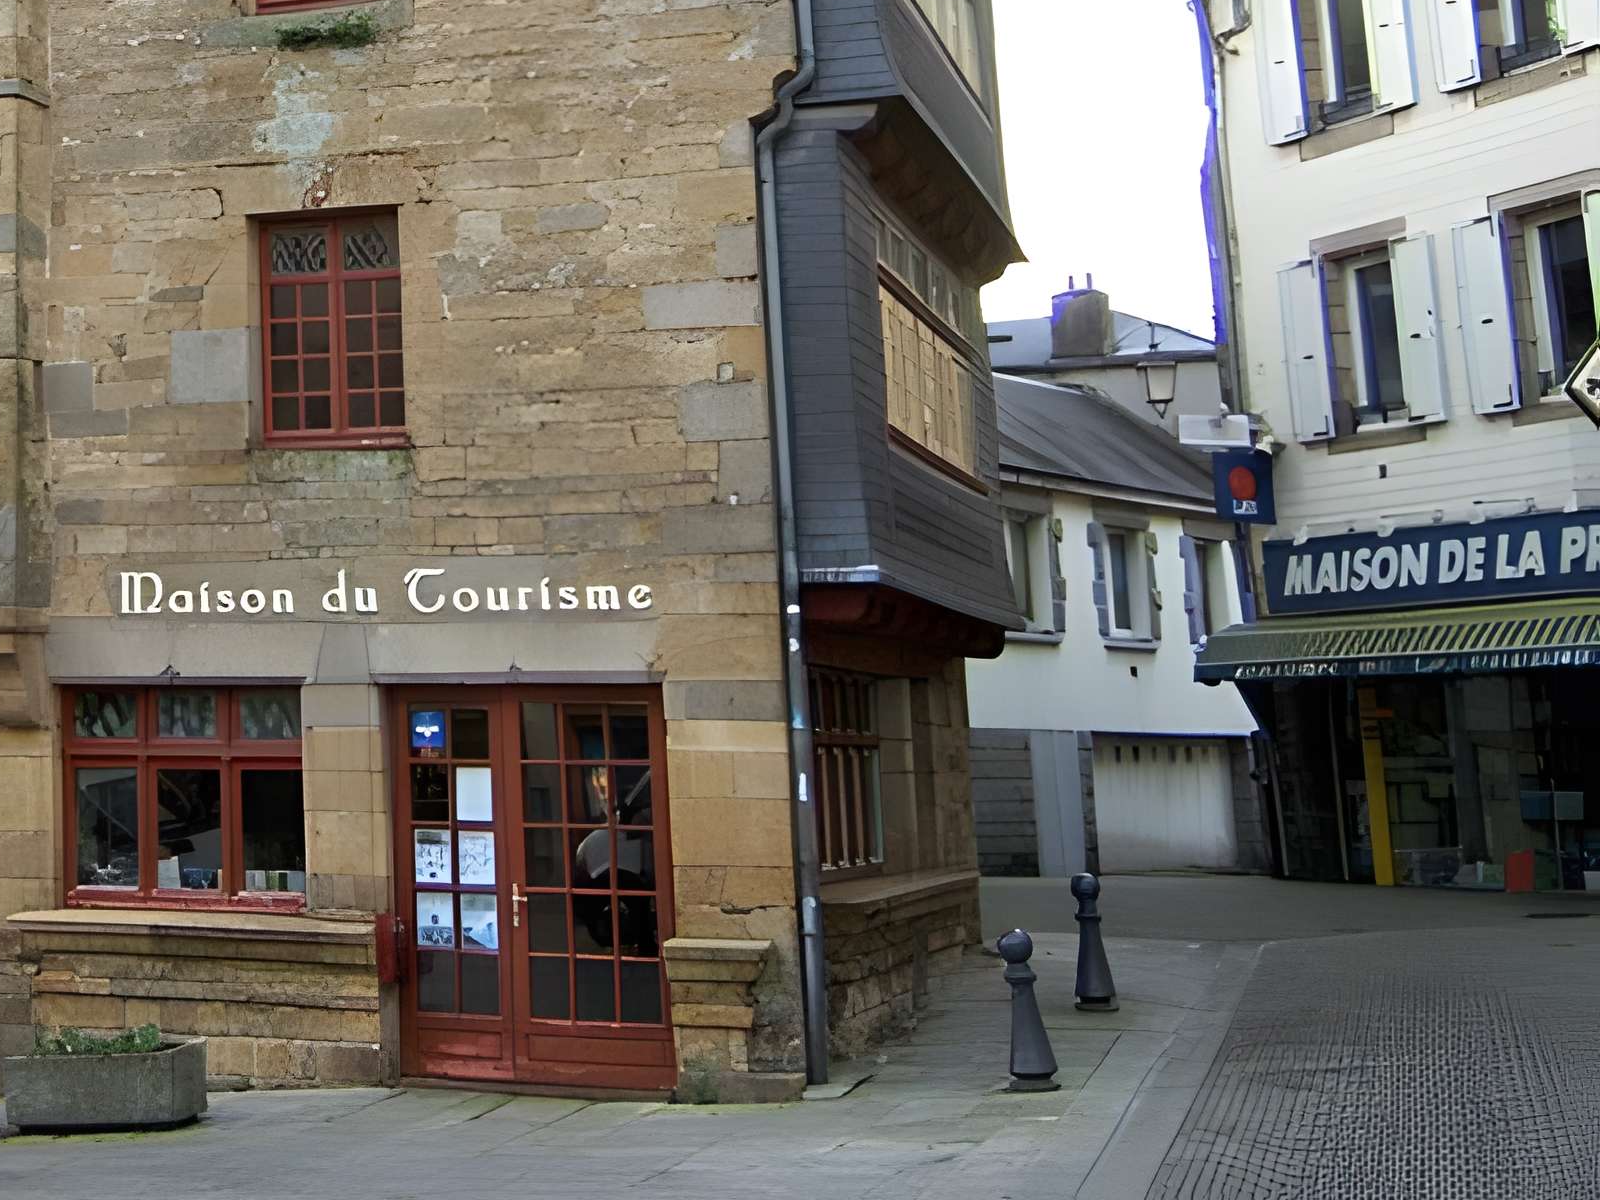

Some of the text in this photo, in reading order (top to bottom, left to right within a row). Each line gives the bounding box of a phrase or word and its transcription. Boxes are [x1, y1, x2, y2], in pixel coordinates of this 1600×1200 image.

[120, 567, 653, 615] Maison du Tourisme
[1284, 542, 1429, 596] MAISON
[1438, 537, 1486, 584] DE
[1496, 530, 1545, 580] LA
